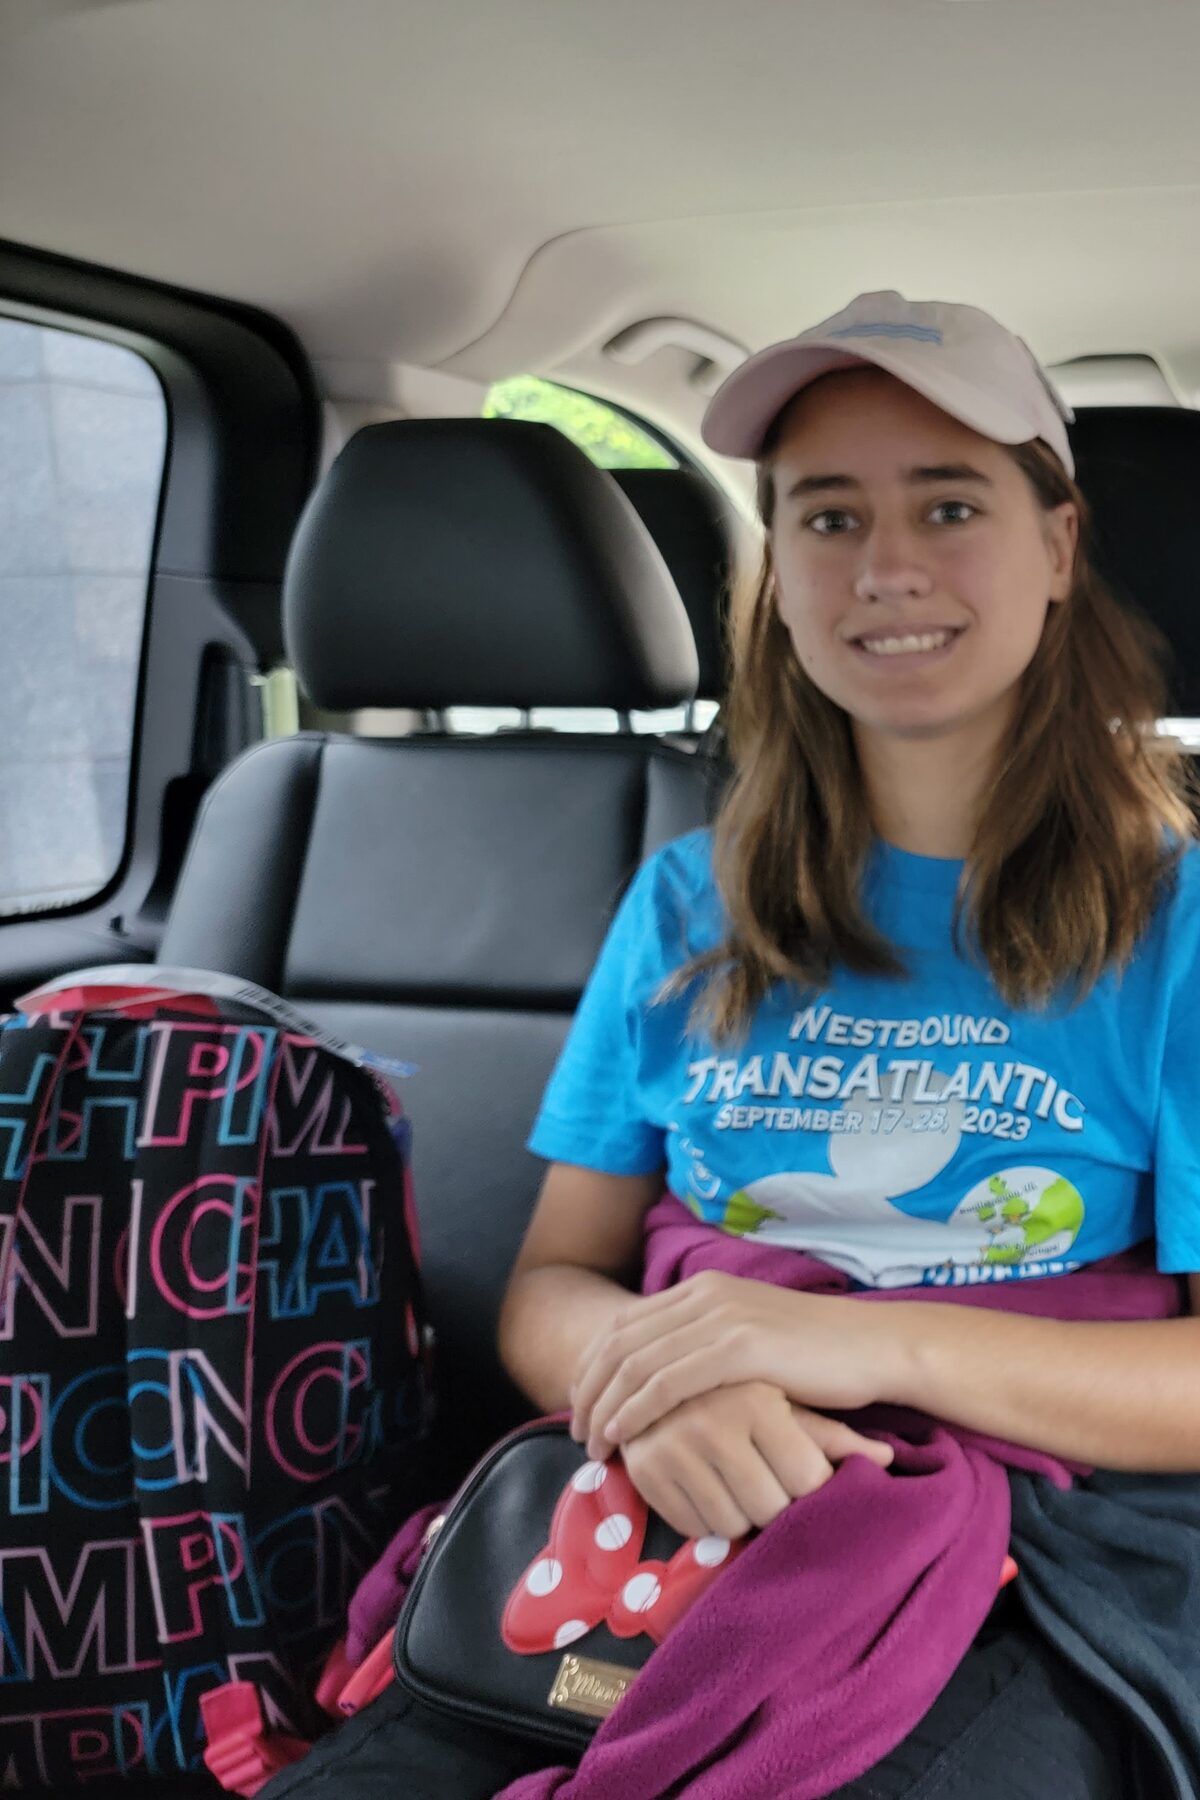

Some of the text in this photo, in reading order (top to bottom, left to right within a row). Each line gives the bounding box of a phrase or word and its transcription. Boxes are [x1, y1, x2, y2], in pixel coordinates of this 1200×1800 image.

[789, 1005, 1011, 1048] WESTBOUND
[684, 1051, 1087, 1132] TRANSATLANTIC
[714, 1103, 863, 1134] SEPTEMBER
[960, 1106, 1032, 1142] 2023
